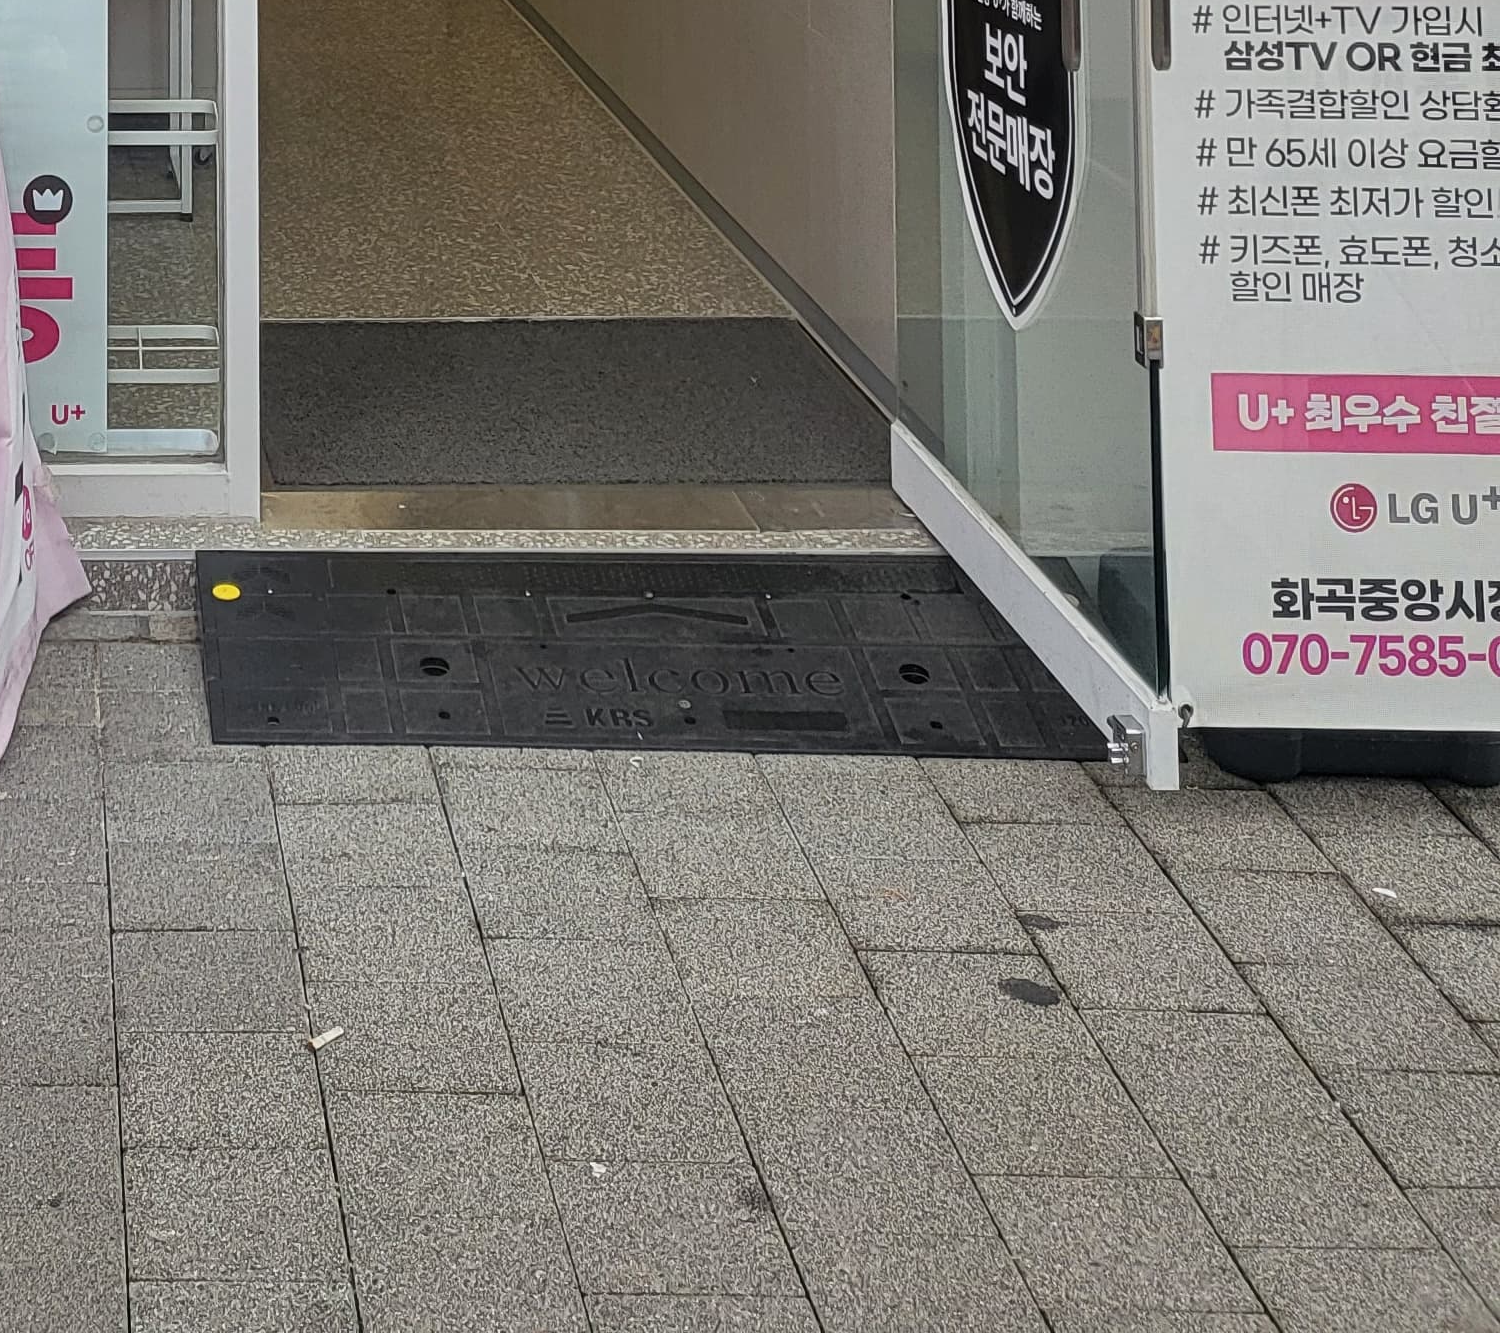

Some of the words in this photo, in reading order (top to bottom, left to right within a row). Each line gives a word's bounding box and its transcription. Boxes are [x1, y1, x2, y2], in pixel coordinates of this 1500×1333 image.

[1222, 3, 1383, 36] 인터넷+TV
[1391, 5, 1483, 37] 가입시
[983, 22, 1029, 107] 보안
[1224, 40, 1338, 73] 삼성TV
[1346, 41, 1403, 72] OR
[1409, 41, 1473, 74] 현금
[1225, 88, 1411, 121] 가족결합할인
[966, 87, 1056, 201] 전문매장
[1226, 137, 1258, 168] 만
[1265, 137, 1338, 169] 65세
[1347, 137, 1410, 170] 이상
[1227, 185, 1321, 218] 최신폰
[1329, 186, 1425, 219] 최저가
[1229, 234, 1331, 270] 키즈폰,
[1339, 234, 1440, 271] 효도폰,
[1229, 270, 1293, 304] 할인
[1302, 270, 1365, 305] 매장
[50, 402, 88, 426] U+
[1237, 393, 1295, 432] U+
[1304, 392, 1423, 434] 최우수
[1387, 491, 1440, 526] LG
[513, 656, 847, 698] welcome
[583, 707, 655, 729] KRS
